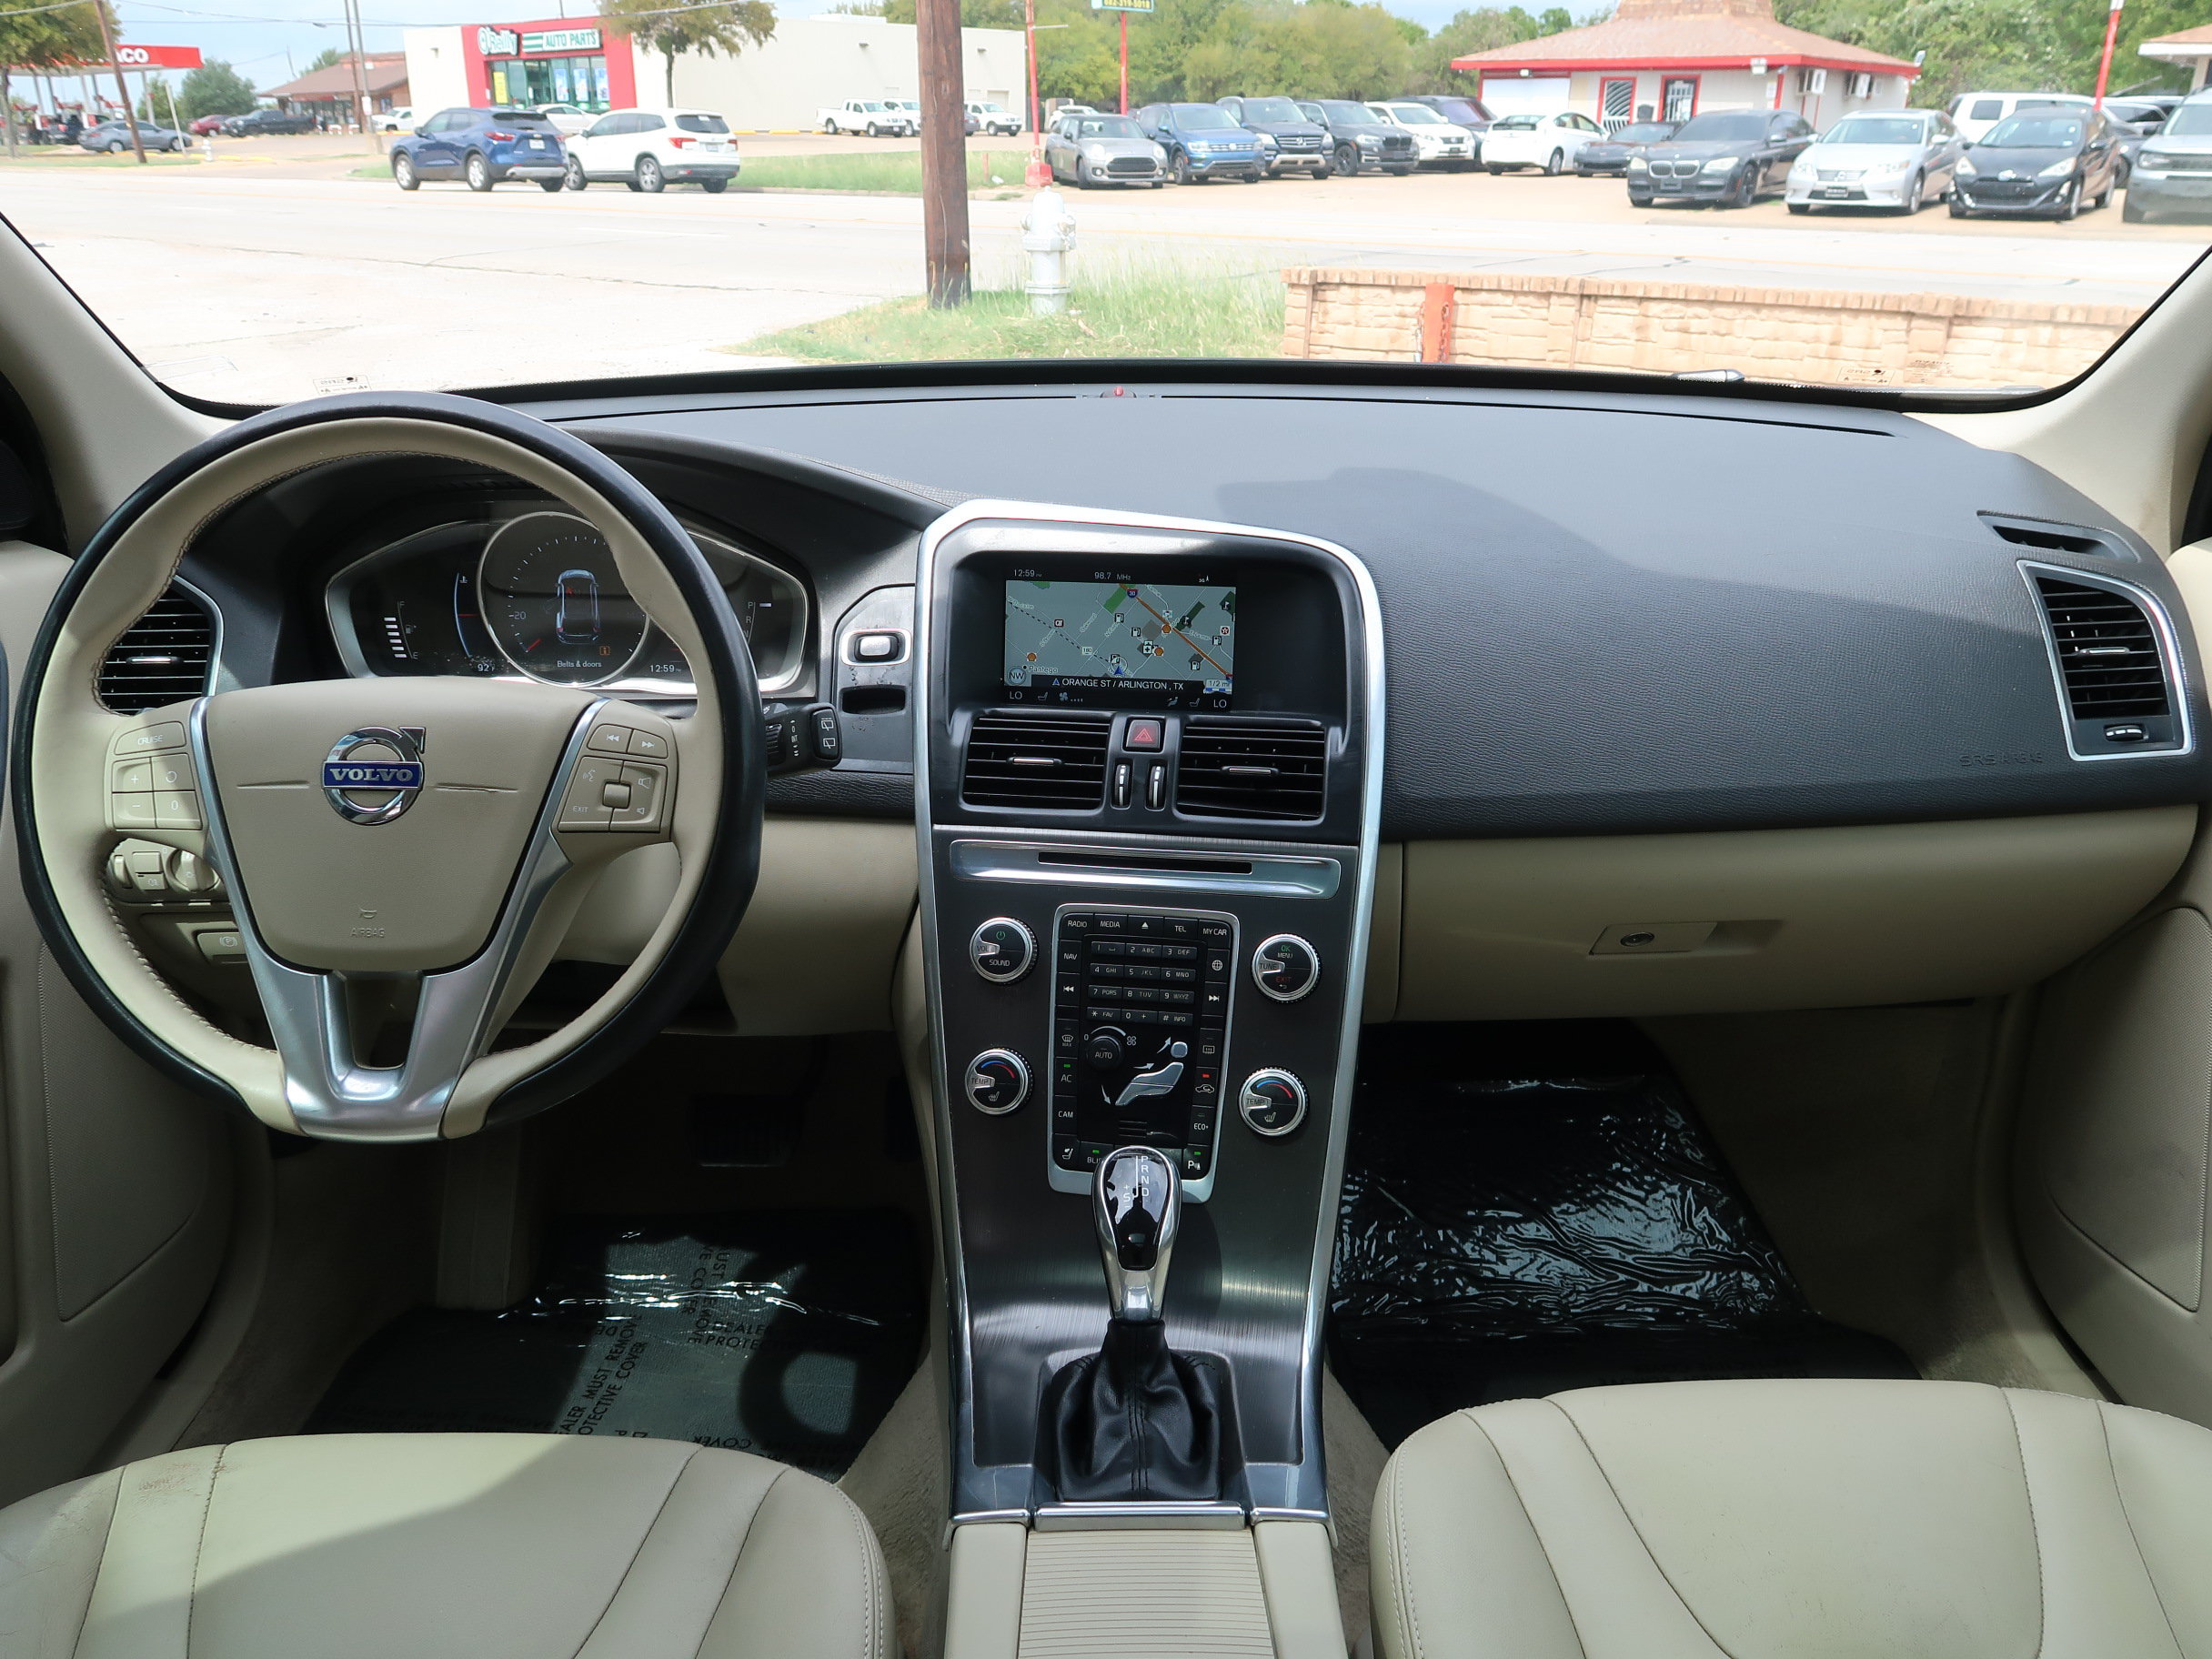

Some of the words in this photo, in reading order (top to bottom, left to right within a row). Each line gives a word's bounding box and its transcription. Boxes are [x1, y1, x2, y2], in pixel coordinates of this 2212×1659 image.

[546, 34, 568, 47] AUTO
[569, 31, 597, 46] PARTS
[1013, 569, 1035, 578] 12:59
[1094, 571, 1111, 579] 98.7
[1116, 573, 1131, 581] MHz
[748, 601, 754, 609] P
[514, 611, 527, 620] 20
[746, 616, 752, 624] R
[477, 664, 489, 672] 92
[649, 664, 675, 673] 12:59
[1029, 666, 1059, 674] Pantego
[1010, 672, 1025, 680] NW
[1061, 678, 1099, 688] ORANGE
[1100, 679, 1112, 688] ST
[1118, 680, 1167, 690] ARLINGTON
[1172, 682, 1184, 690] TX
[1009, 691, 1023, 699] LO
[1213, 699, 1227, 709] LO
[137, 734, 164, 746] CRUISE
[1958, 753, 1997, 767] SRS
[329, 768, 414, 782] VOLVO
[572, 805, 589, 814] EXIT
[1067, 920, 1088, 928] RADIO
[1100, 920, 1121, 929] MEDIA
[1174, 925, 1187, 933] TEL
[1213, 928, 1228, 936] CAR
[1063, 952, 1078, 960] NAV
[989, 959, 1010, 967] SOUND
[1127, 990, 1132, 998] 8
[1094, 1051, 1113, 1060] AUTO
[971, 1077, 989, 1085] TEMP
[1061, 1074, 1072, 1082] AC
[1058, 1111, 1074, 1119] CAM
[1193, 1122, 1209, 1131] ECO+
[1141, 1155, 1149, 1163] P
[1141, 1164, 1149, 1173] R
[1141, 1175, 1150, 1184] N
[1141, 1187, 1150, 1197] D
[1122, 1192, 1131, 1202] S
[578, 1383, 623, 1435] OTECTIVE
[615, 1341, 649, 1380] COVER
[582, 1367, 614, 1400] MUST
[693, 1434, 753, 1449] COVER
